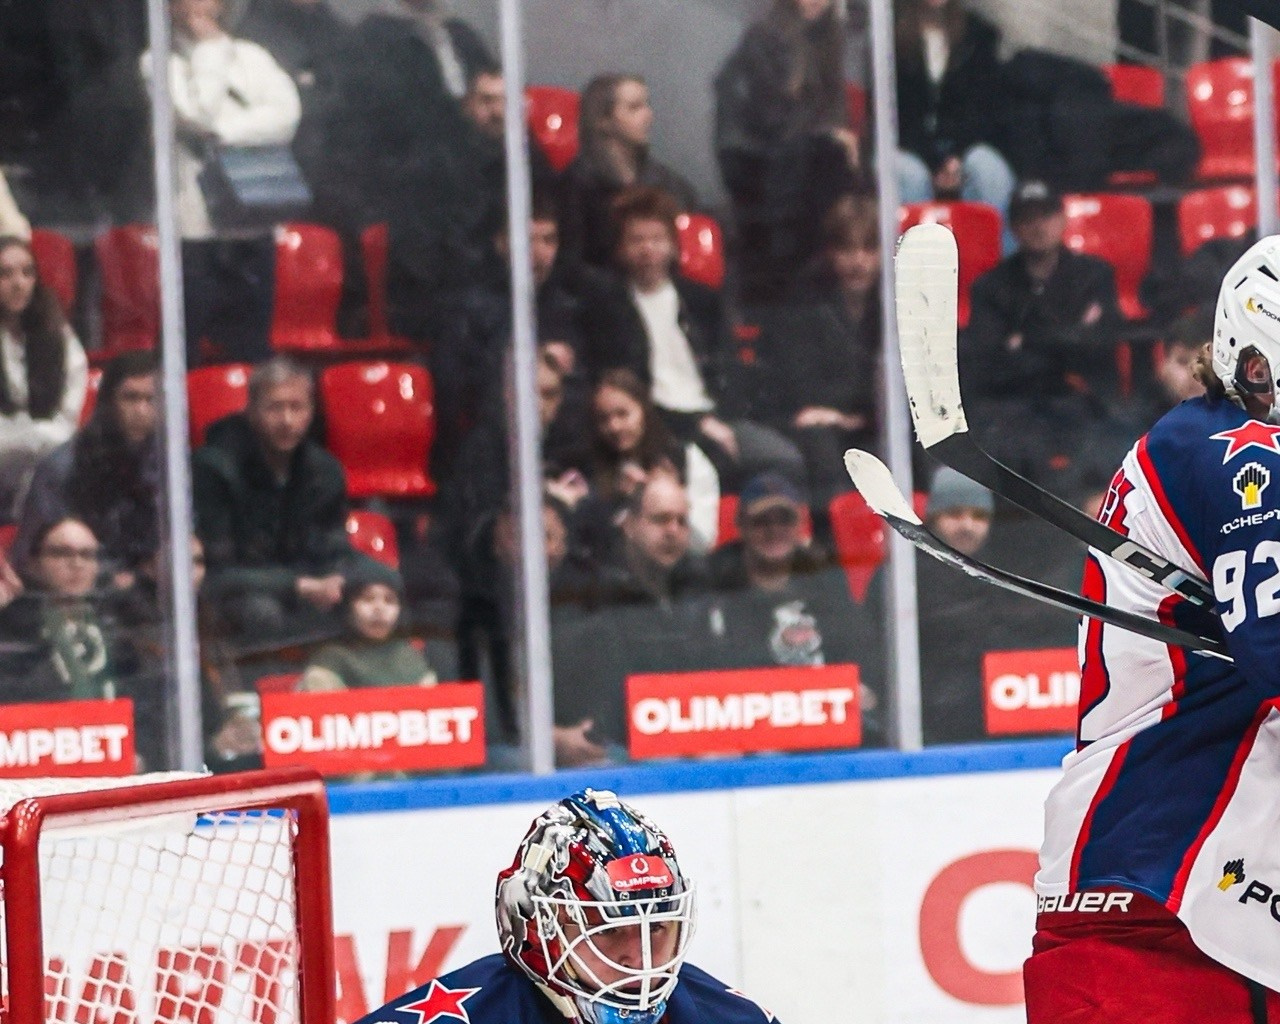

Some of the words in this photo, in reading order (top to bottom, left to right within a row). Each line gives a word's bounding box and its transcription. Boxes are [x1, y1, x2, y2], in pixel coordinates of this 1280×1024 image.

[1110, 541, 1216, 606] CC
[267, 706, 479, 754] OLIMPBET
[633, 688, 854, 736] OLIMPBET
